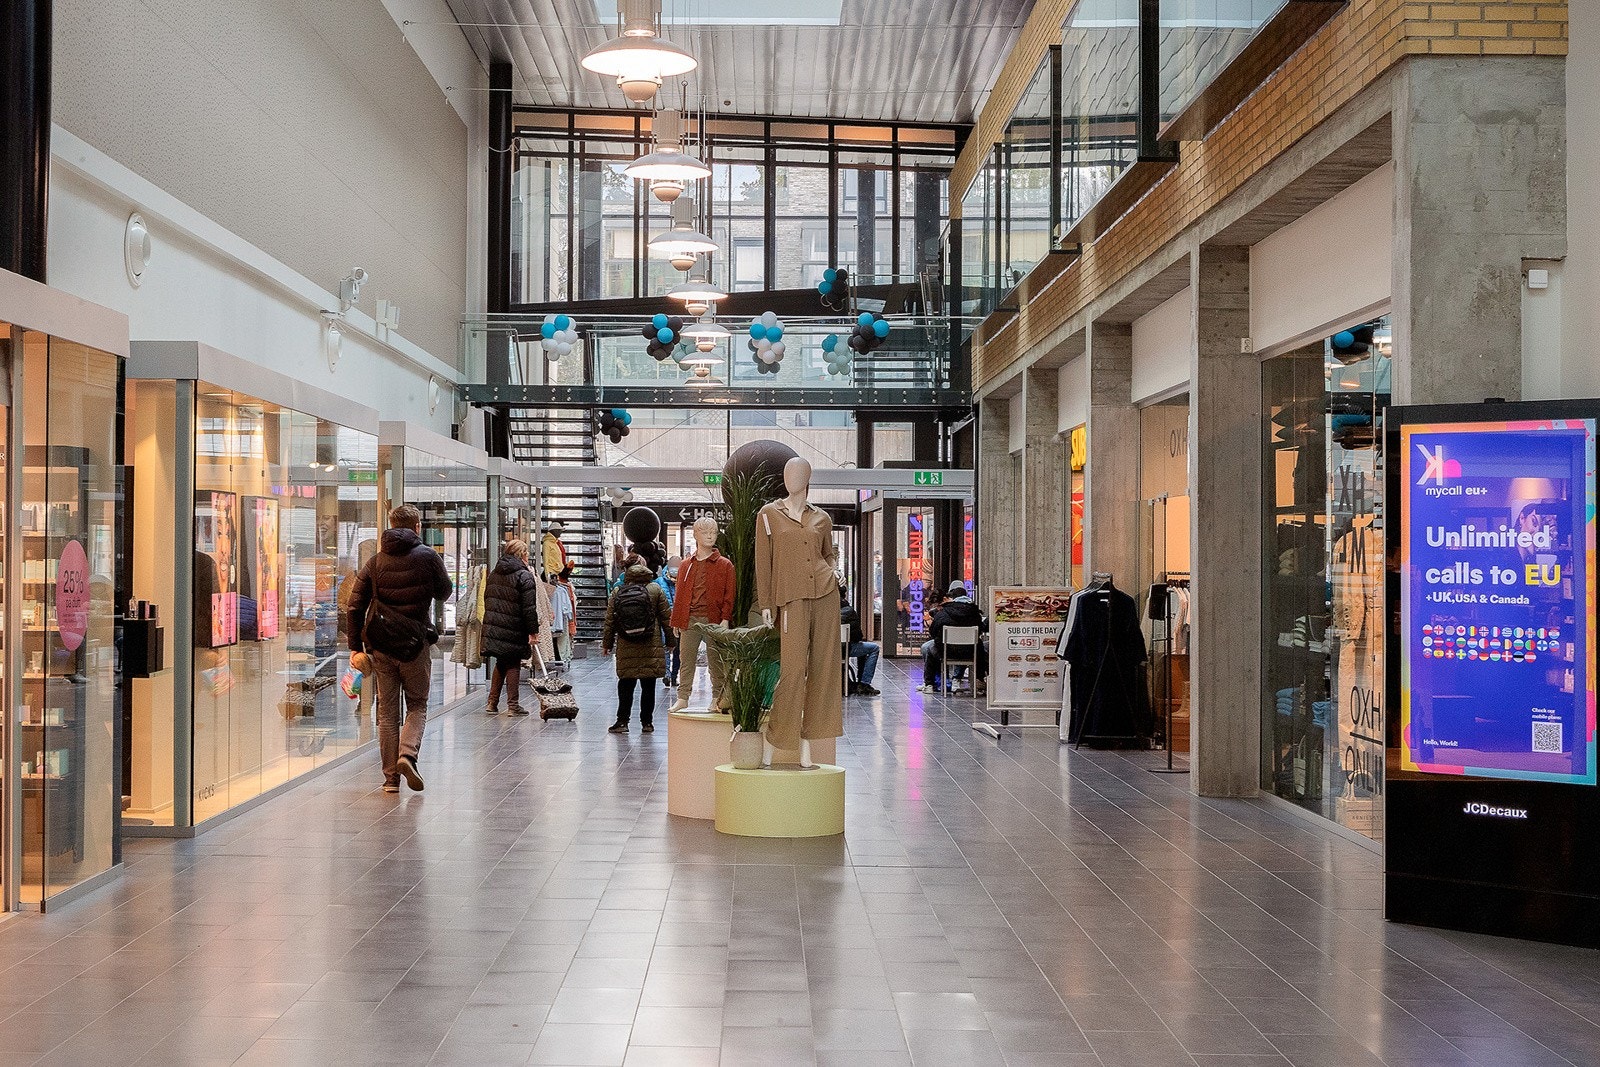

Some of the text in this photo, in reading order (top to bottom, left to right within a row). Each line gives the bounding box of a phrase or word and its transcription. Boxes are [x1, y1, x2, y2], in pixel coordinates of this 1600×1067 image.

[1425, 485, 1488, 498] mycall eu+
[1426, 525, 1551, 548] Unlimited
[63, 570, 84, 594] 25%
[909, 531, 924, 633] INTERSPORT
[1425, 561, 1561, 586] calls to EU
[1479, 594, 1488, 604] &
[1489, 595, 1530, 605] Canada
[1007, 627, 1058, 635] SUB OF THE DAY
[1463, 802, 1528, 819] JCDecaux
